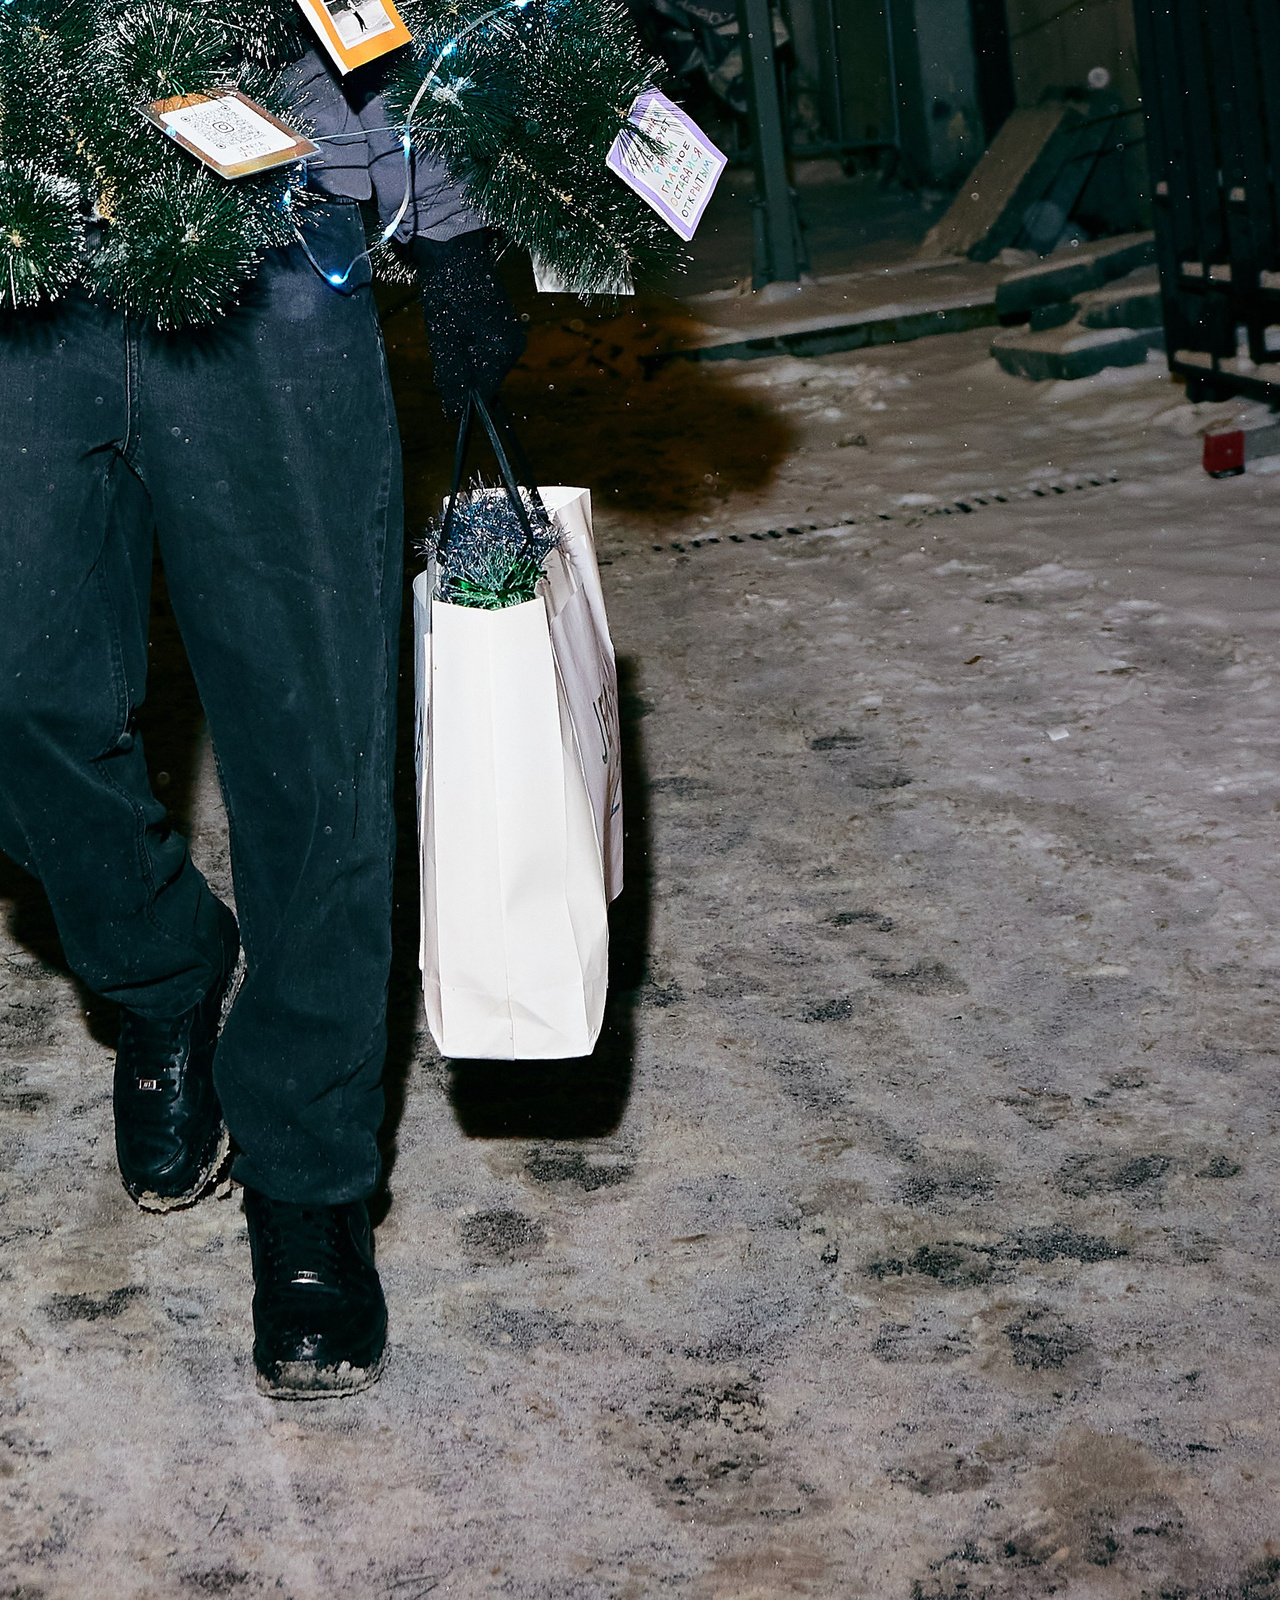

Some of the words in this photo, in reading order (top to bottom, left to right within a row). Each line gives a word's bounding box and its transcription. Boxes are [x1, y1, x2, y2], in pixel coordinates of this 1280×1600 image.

[661, 140, 690, 194] ГЛАВНОЕ
[668, 145, 703, 207] ОСТАВАЙСЯ
[680, 159, 714, 218] ОТКРЫТЫМ
